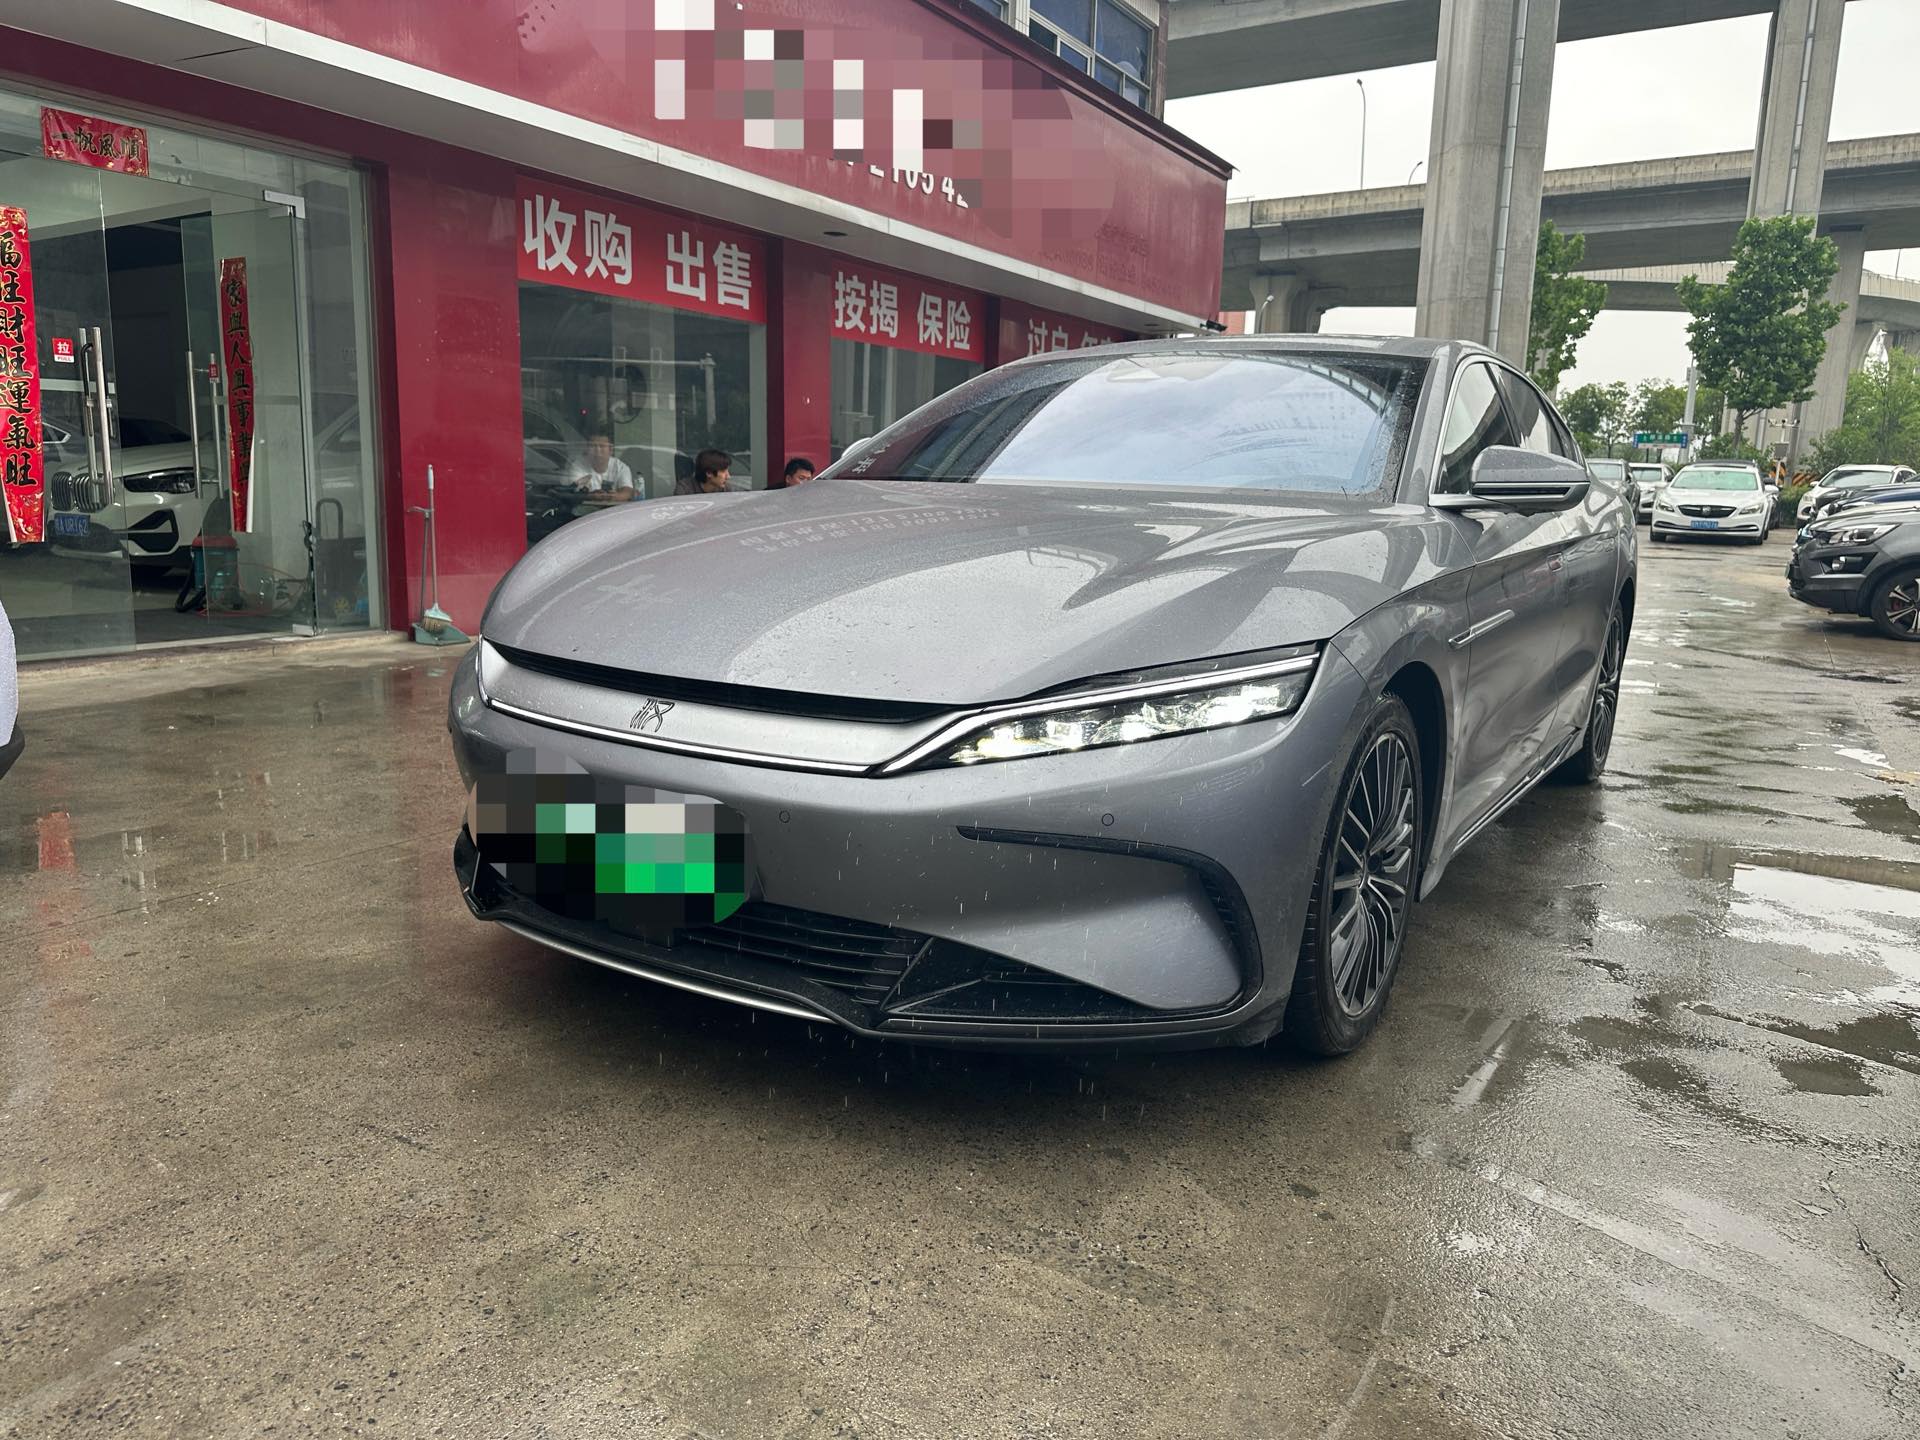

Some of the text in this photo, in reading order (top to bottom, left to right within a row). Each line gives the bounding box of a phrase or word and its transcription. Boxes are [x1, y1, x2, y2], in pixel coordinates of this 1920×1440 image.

[523, 194, 752, 310] 收购 出售
[57, 341, 71, 354] 拉
[834, 271, 971, 351] 按揭 保险
